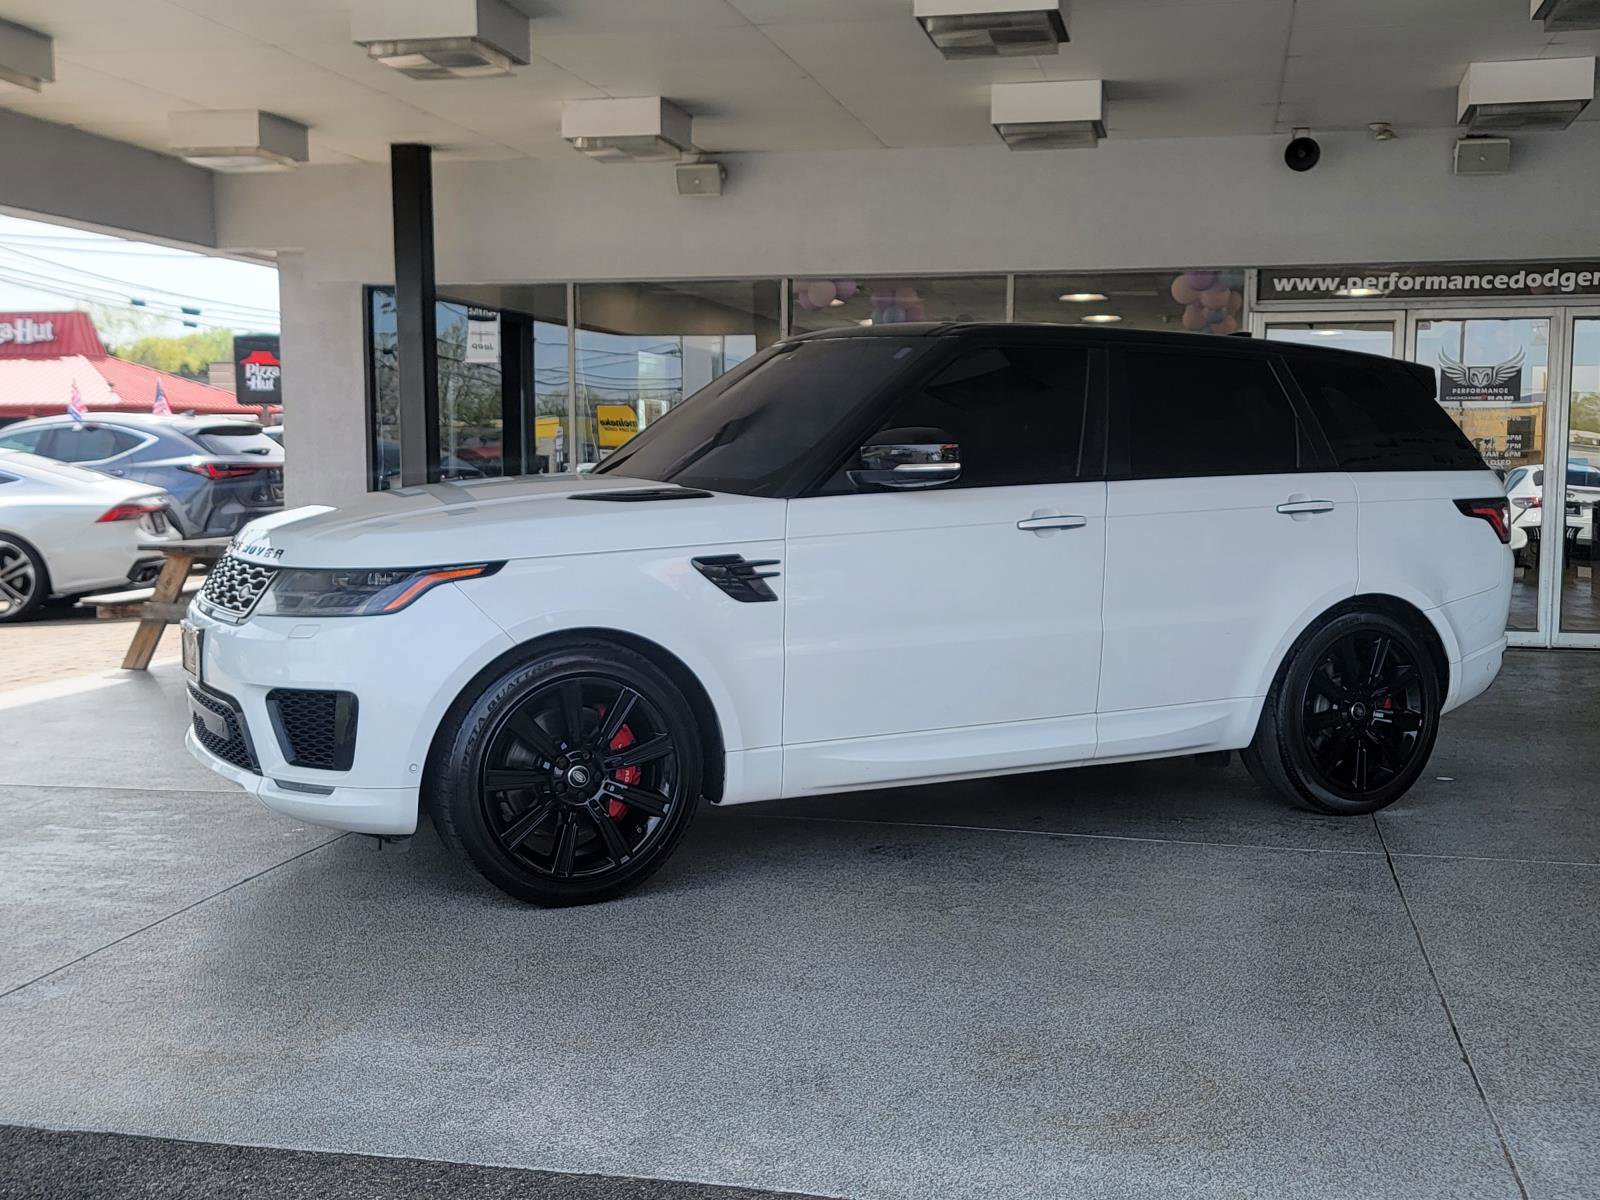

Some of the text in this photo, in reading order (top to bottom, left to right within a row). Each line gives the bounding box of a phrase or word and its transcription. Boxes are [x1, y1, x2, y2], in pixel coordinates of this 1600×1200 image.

[16, 318, 54, 344] Hut
[245, 362, 280, 378] Pizza
[246, 376, 274, 390] Hut
